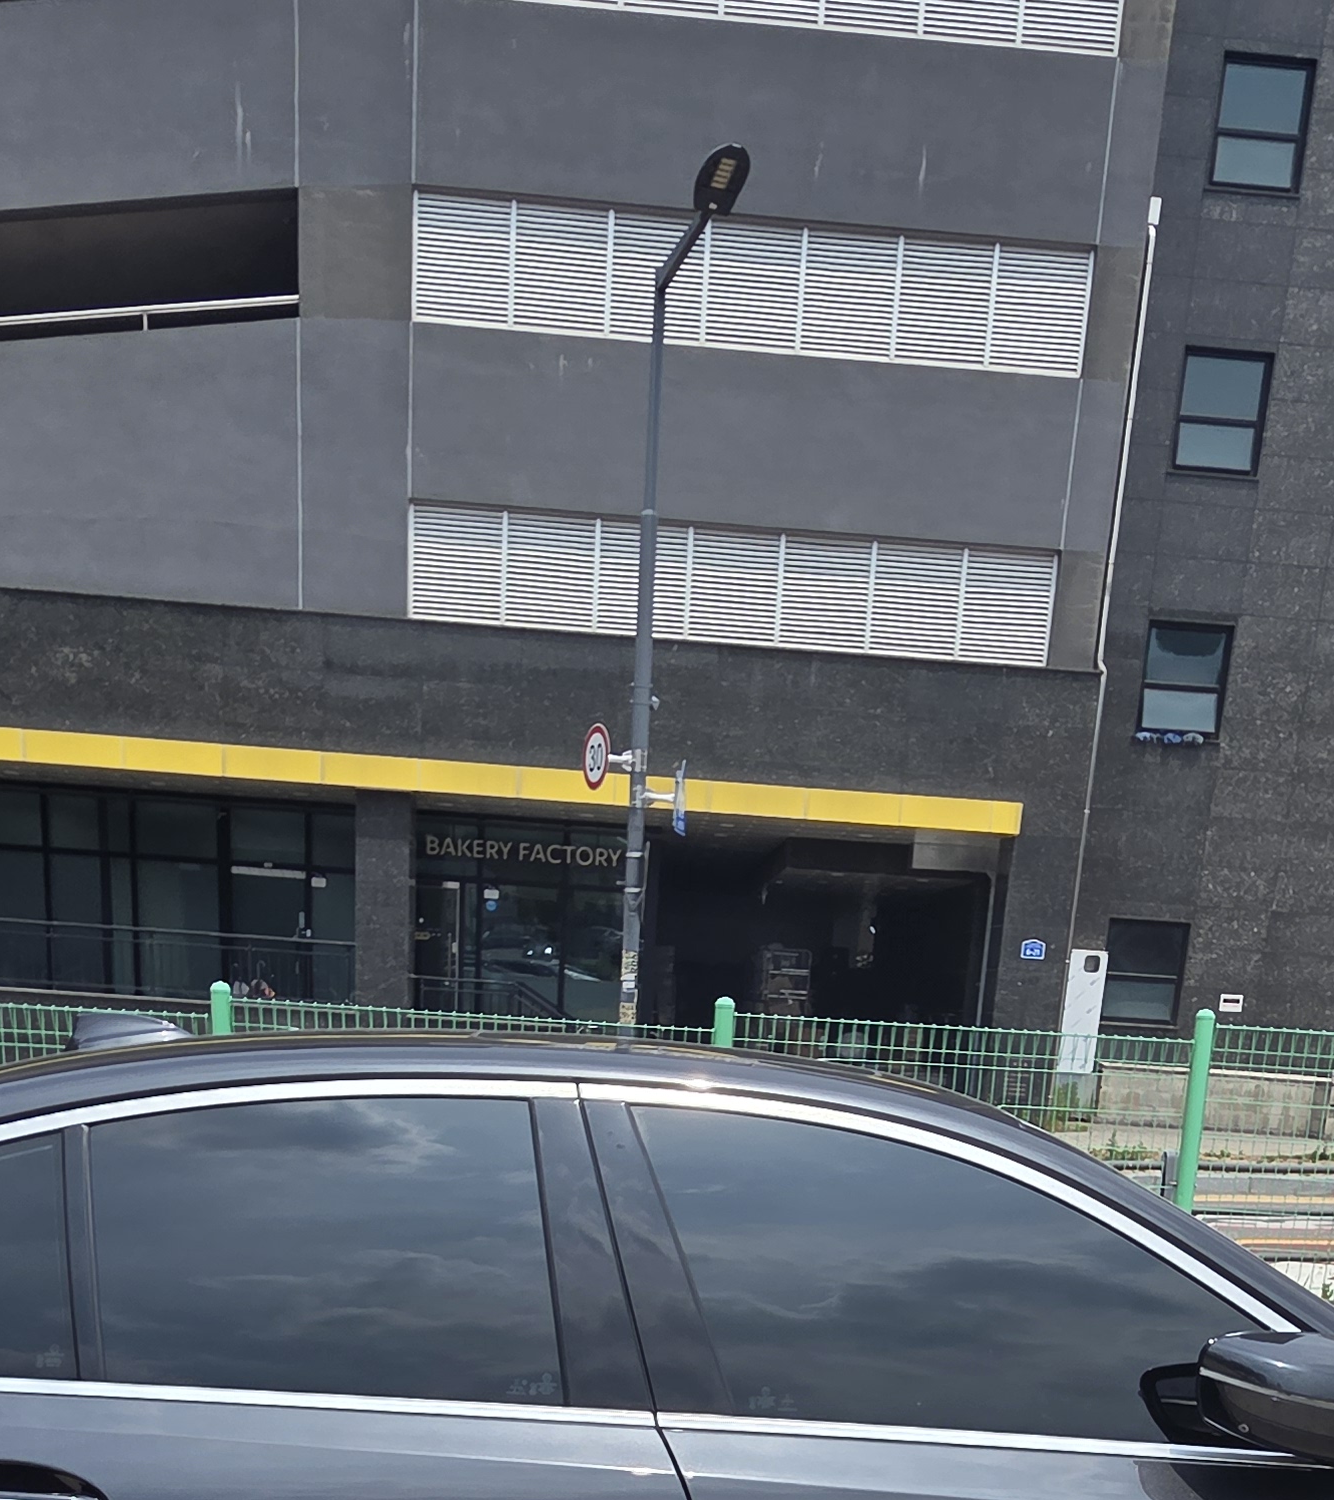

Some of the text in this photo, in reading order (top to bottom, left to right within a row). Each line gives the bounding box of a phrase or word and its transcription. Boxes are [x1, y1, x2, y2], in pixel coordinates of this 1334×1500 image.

[589, 743, 603, 772] 30
[425, 835, 622, 867] BAKERY FACTORY
